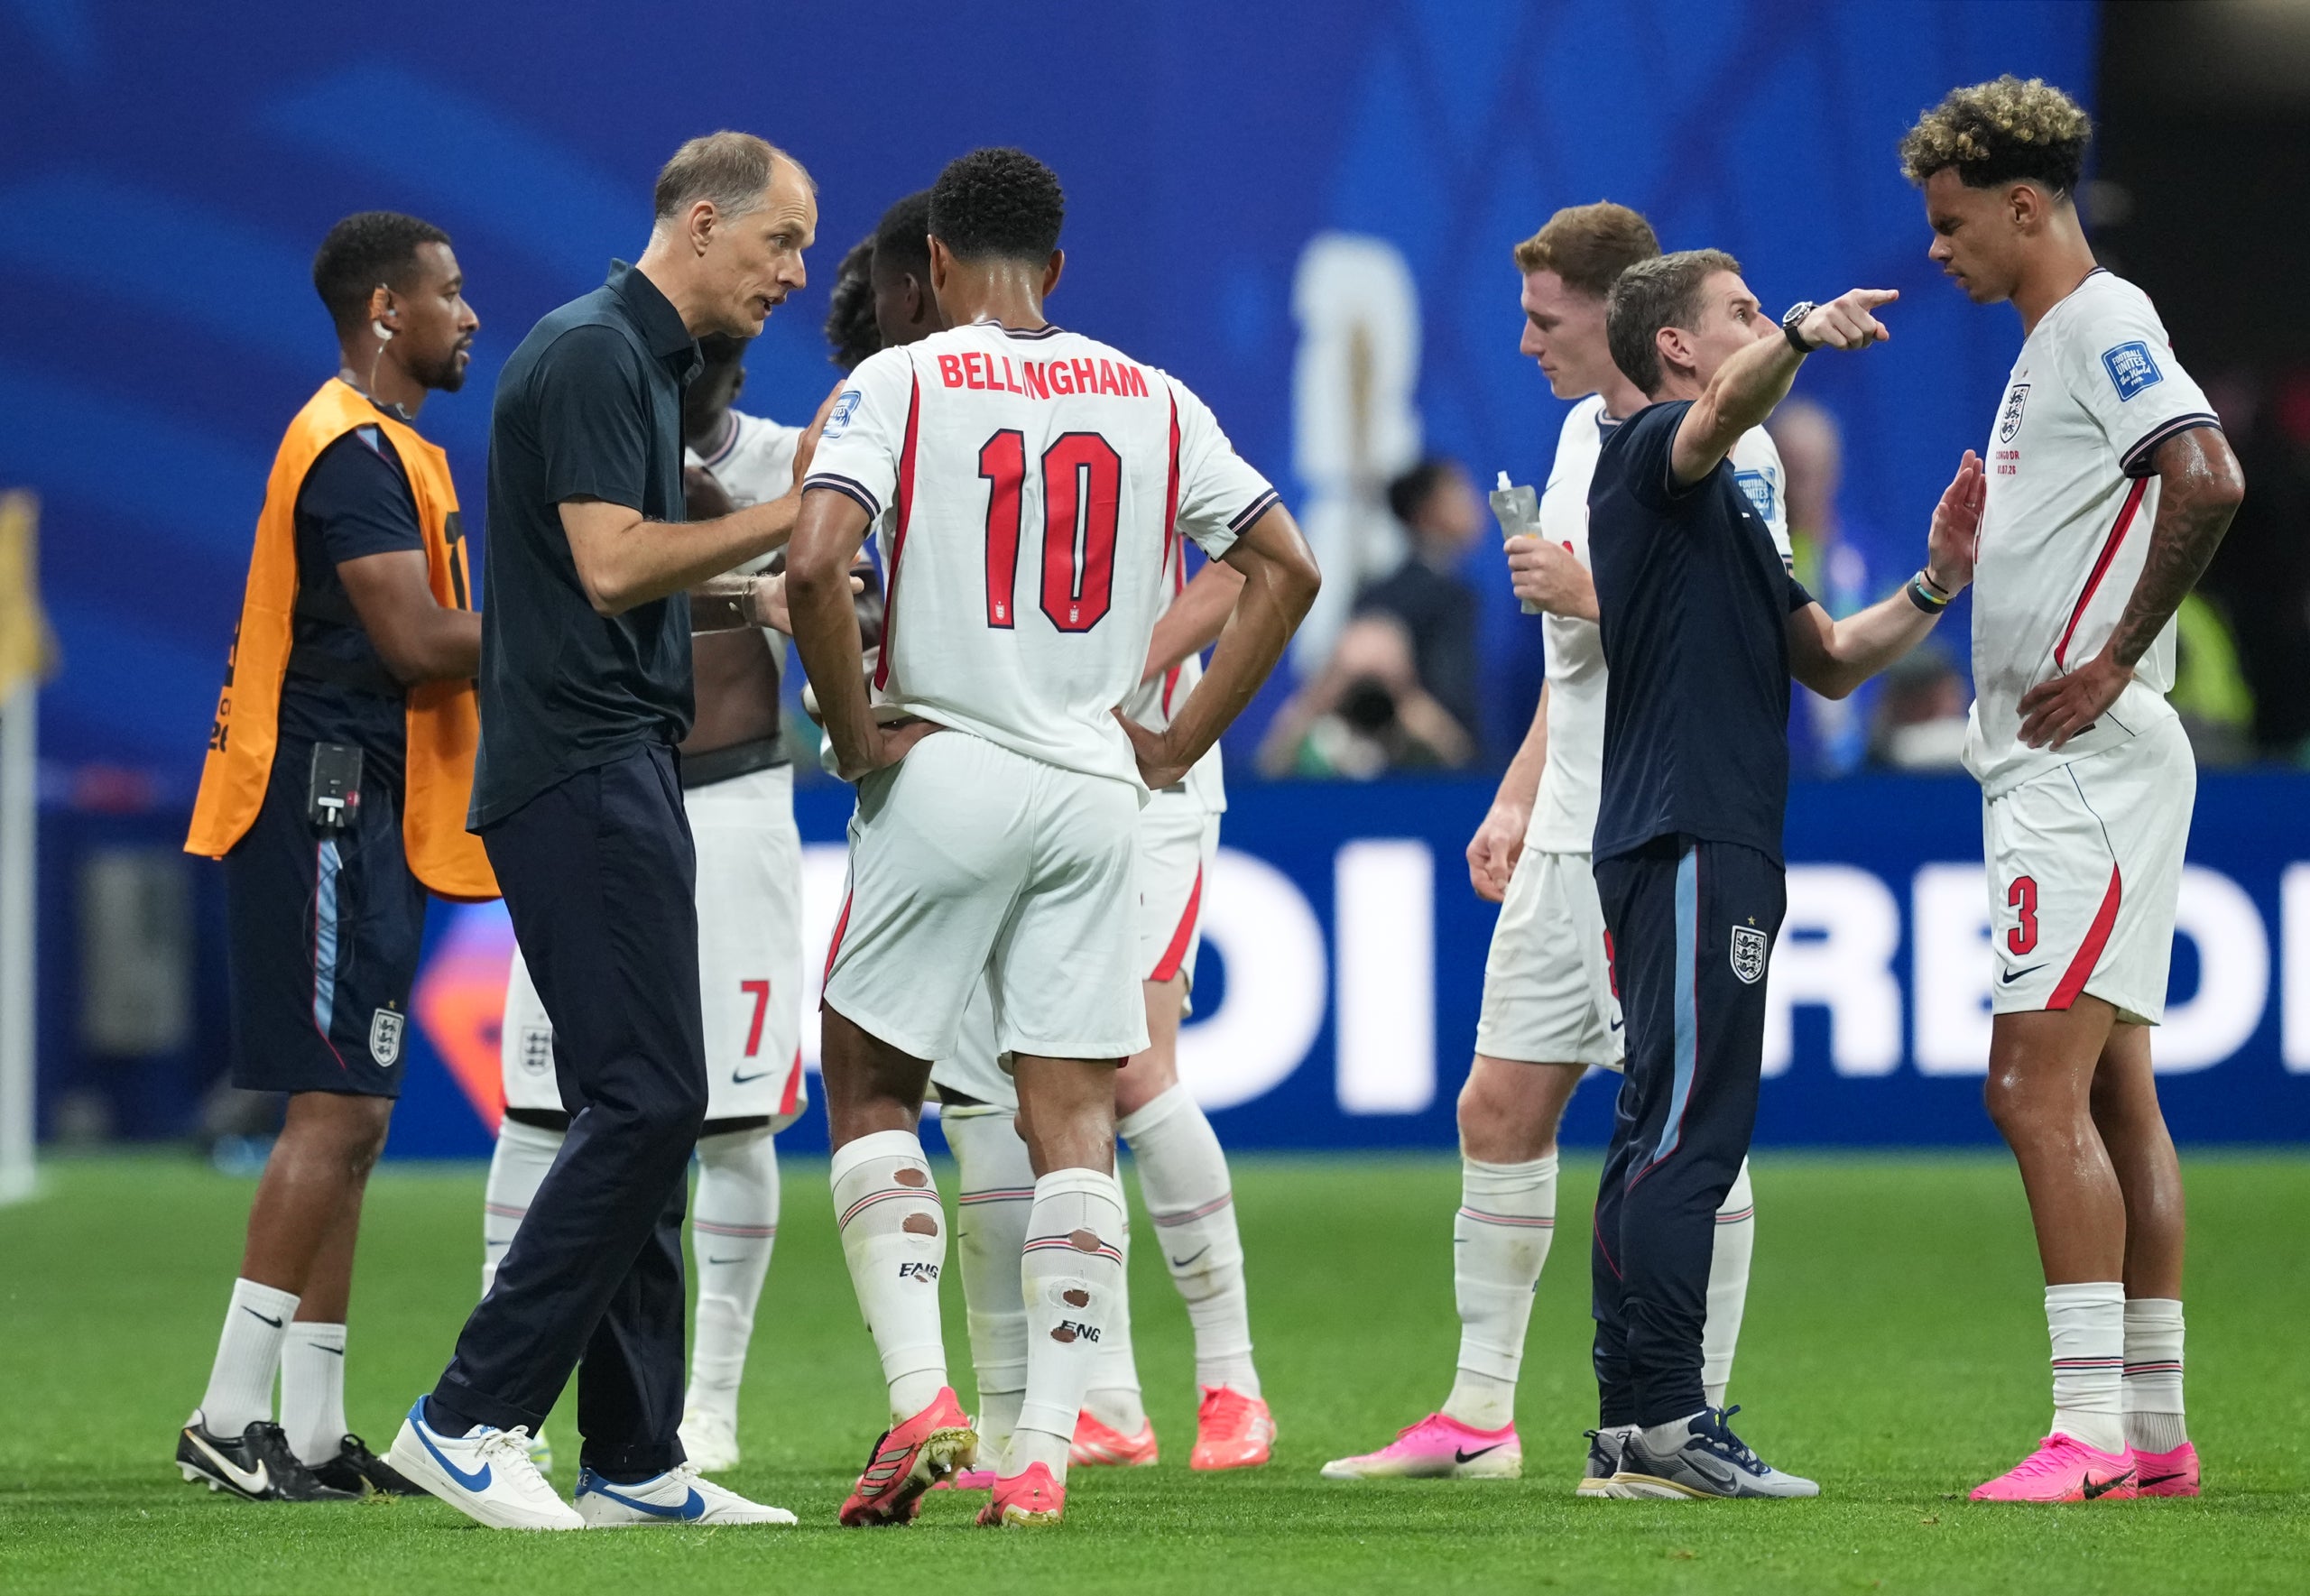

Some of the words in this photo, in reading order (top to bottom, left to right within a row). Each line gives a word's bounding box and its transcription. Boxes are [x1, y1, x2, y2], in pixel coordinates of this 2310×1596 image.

[2111, 348, 2143, 365] FOOTBALL
[2115, 356, 2147, 375] UNITES
[938, 352, 1149, 401] BELLINGHAM
[2130, 364, 2152, 379] World
[2010, 450, 2020, 460] DR
[978, 428, 1122, 633] 10
[2008, 875, 2037, 956] 3
[741, 980, 770, 1057] 7
[1058, 1319, 1101, 1343] ENG
